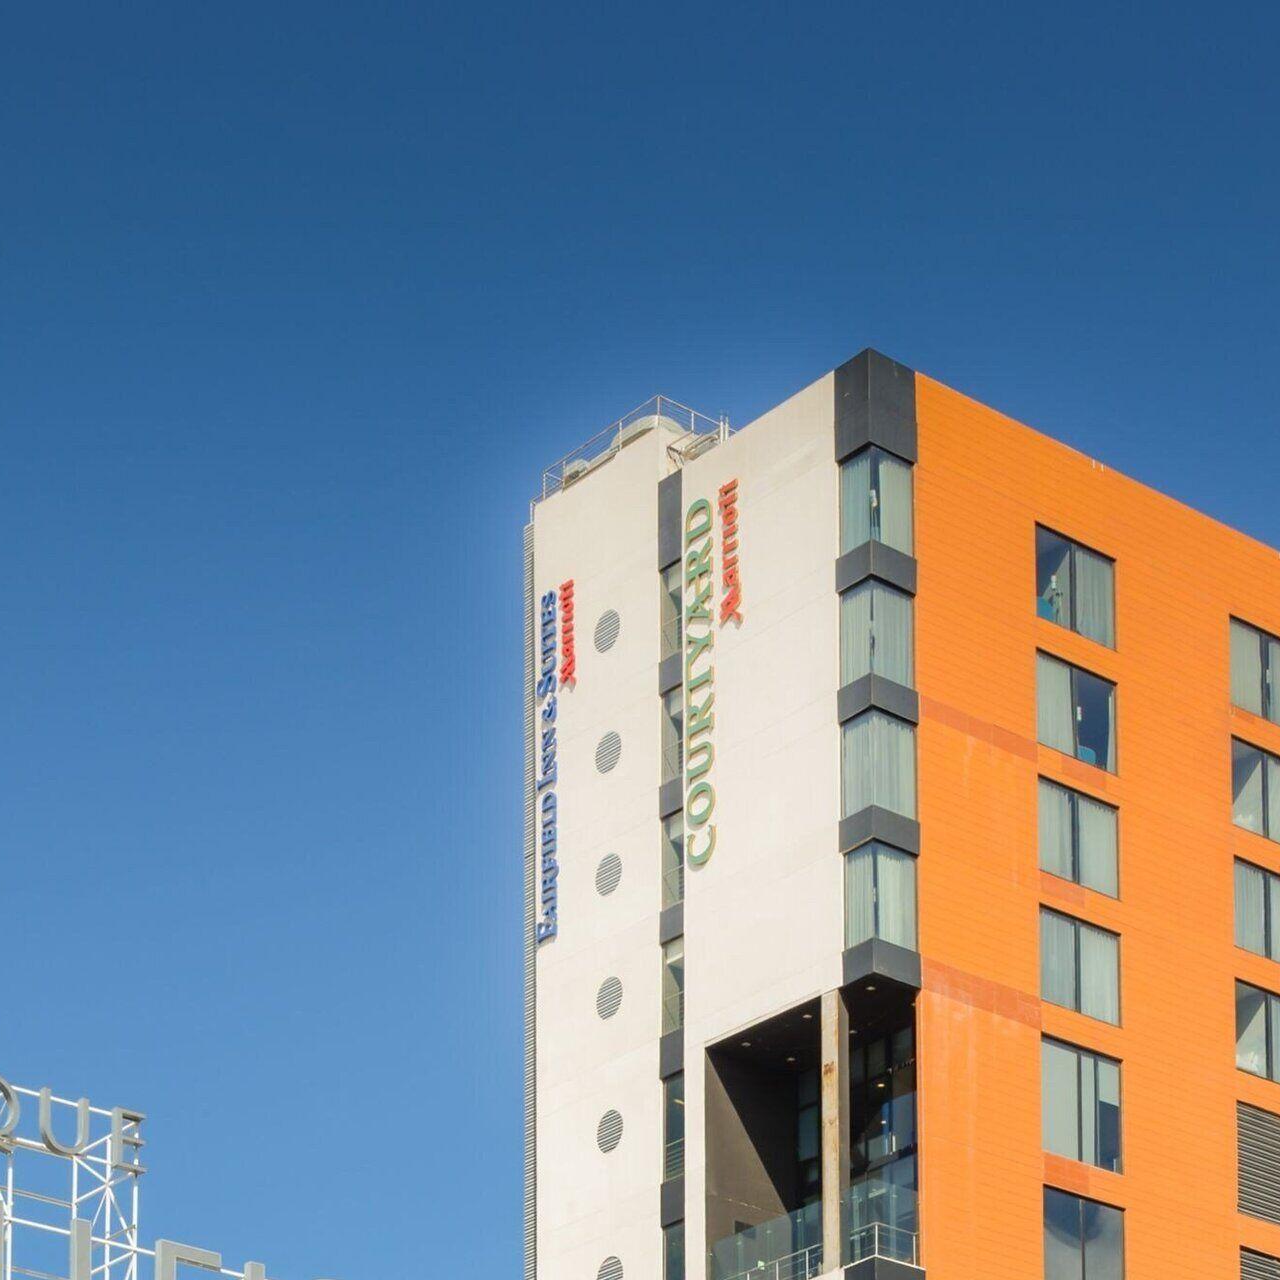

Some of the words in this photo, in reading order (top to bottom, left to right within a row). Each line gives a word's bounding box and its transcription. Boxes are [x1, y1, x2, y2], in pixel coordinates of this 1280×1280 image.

[719, 479, 742, 627] Marriott
[537, 590, 559, 696] SUITES
[686, 498, 716, 868] COURTYARD
[537, 730, 558, 793] INN
[541, 696, 558, 723] &
[537, 794, 559, 943] FAIRFIELD
